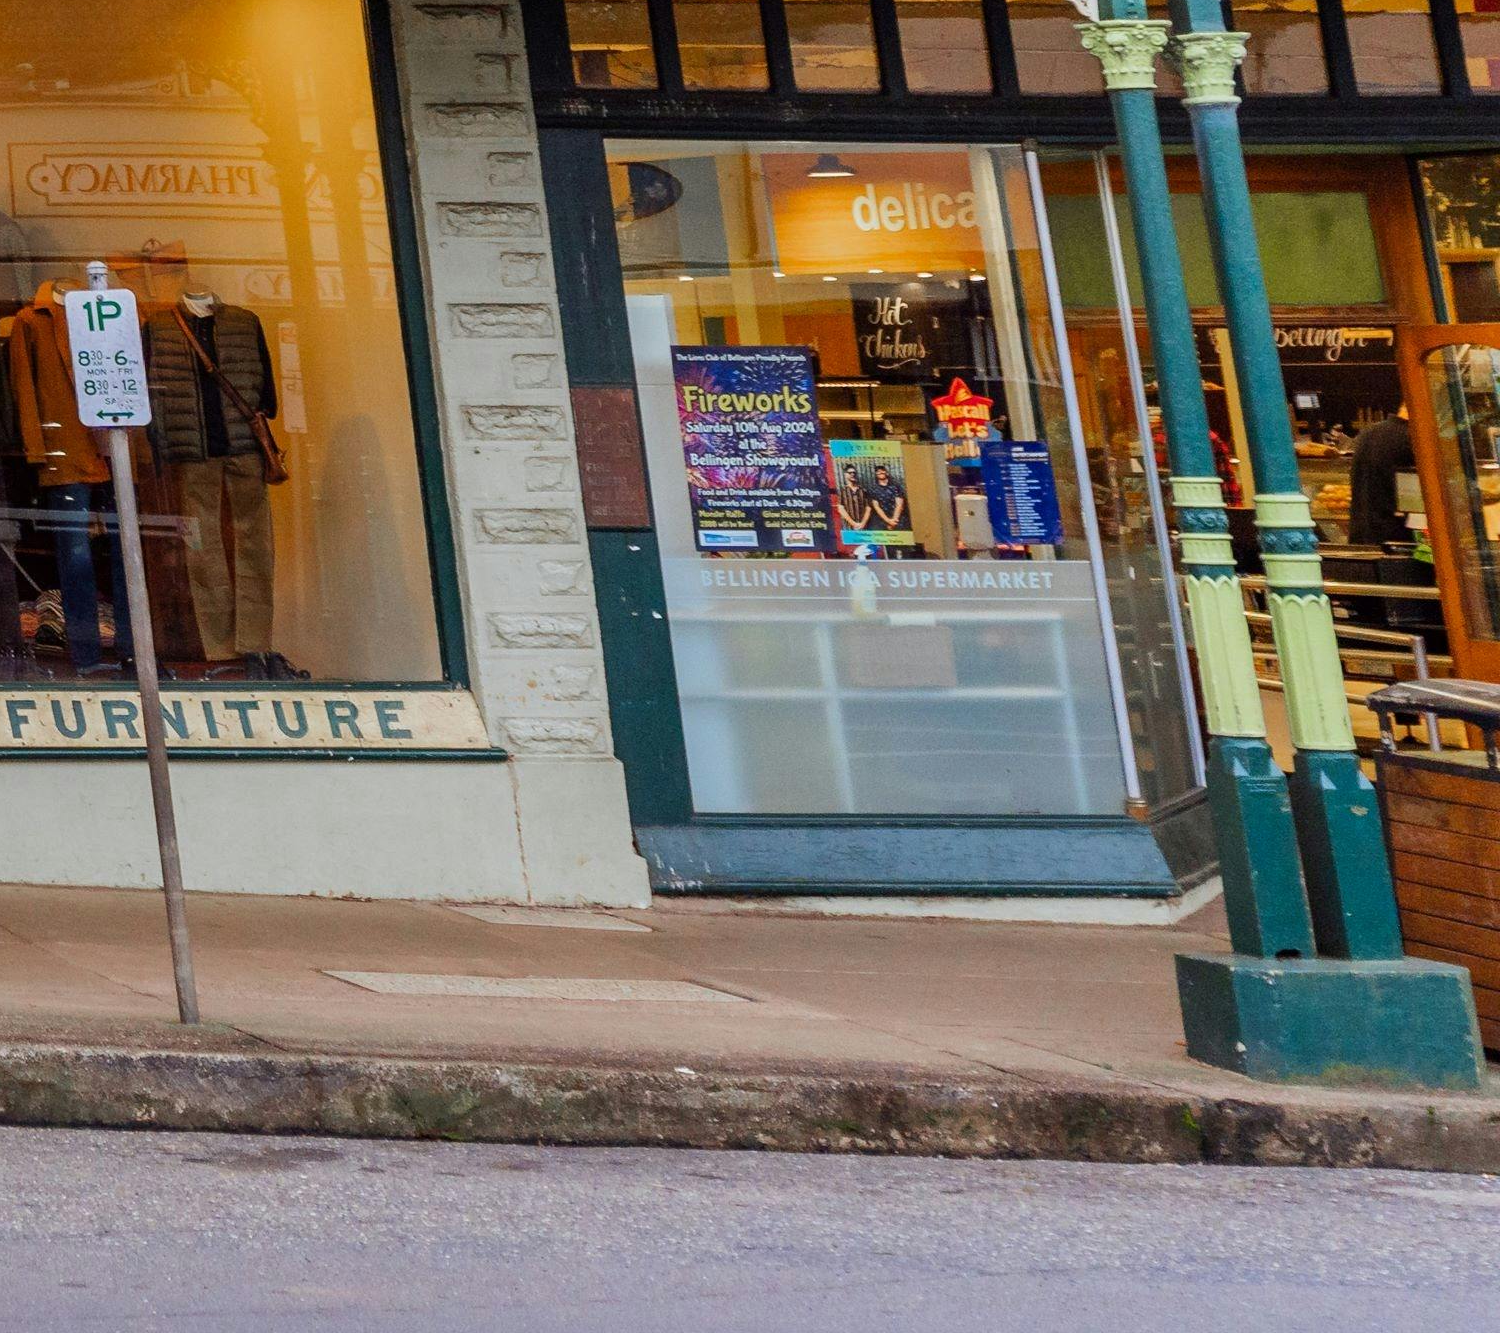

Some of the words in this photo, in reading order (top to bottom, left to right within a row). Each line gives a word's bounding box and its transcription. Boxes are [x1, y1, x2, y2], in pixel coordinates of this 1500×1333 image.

[82, 300, 121, 331] 1P
[868, 296, 913, 325] Hot
[682, 385, 812, 413] Fireworks
[685, 422, 733, 436] Saturday
[735, 422, 758, 433] 10th
[761, 422, 783, 436] Aug
[783, 422, 815, 433] 2024
[739, 439, 748, 449] at
[749, 439, 766, 449] the
[690, 453, 744, 469] Bellingen
[745, 453, 819, 469] Showground
[700, 570, 829, 588] BELLINGEN
[888, 571, 1054, 589] SUPERMARKET
[6, 699, 414, 740] FURNITURE
